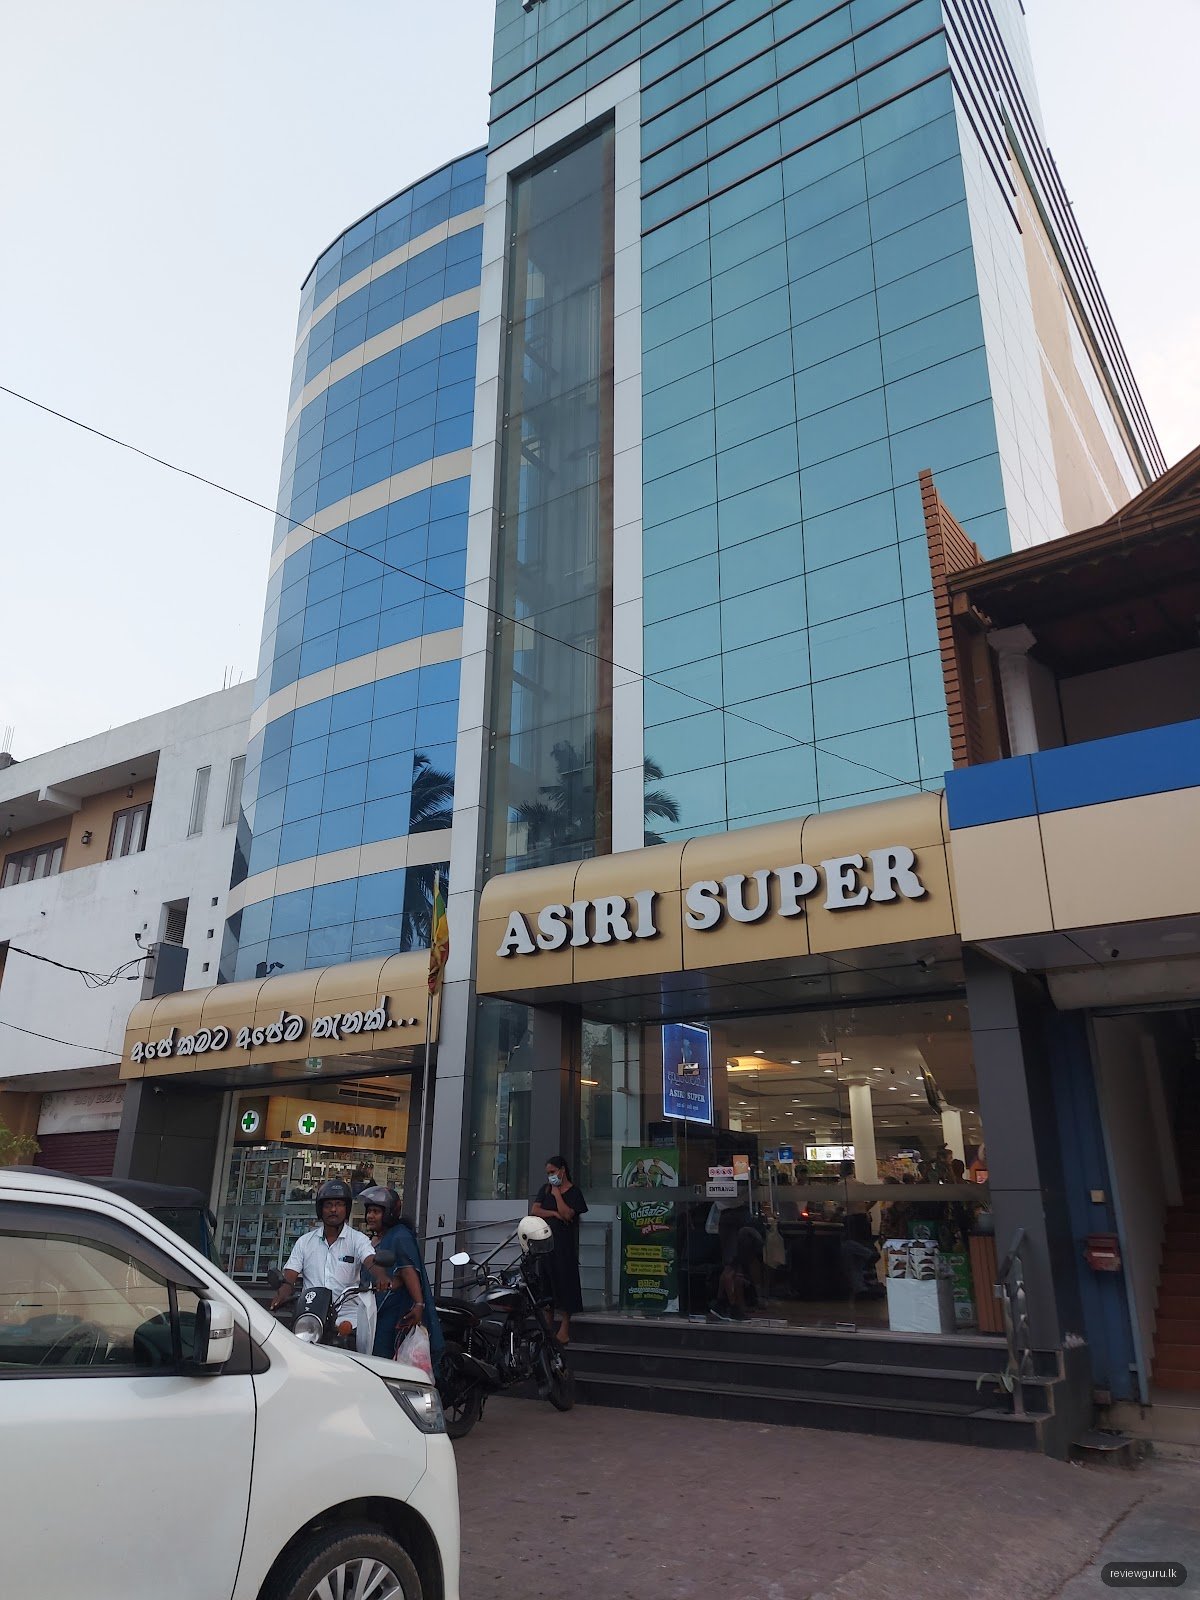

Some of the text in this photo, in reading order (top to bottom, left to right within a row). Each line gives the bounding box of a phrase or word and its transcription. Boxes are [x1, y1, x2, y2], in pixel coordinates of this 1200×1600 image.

[496, 845, 928, 958] ASIRI SUPER
[235, 1010, 304, 1050] අපේම
[669, 1088, 706, 1104] ASIR SUPER
[636, 1216, 664, 1226] BIKE
